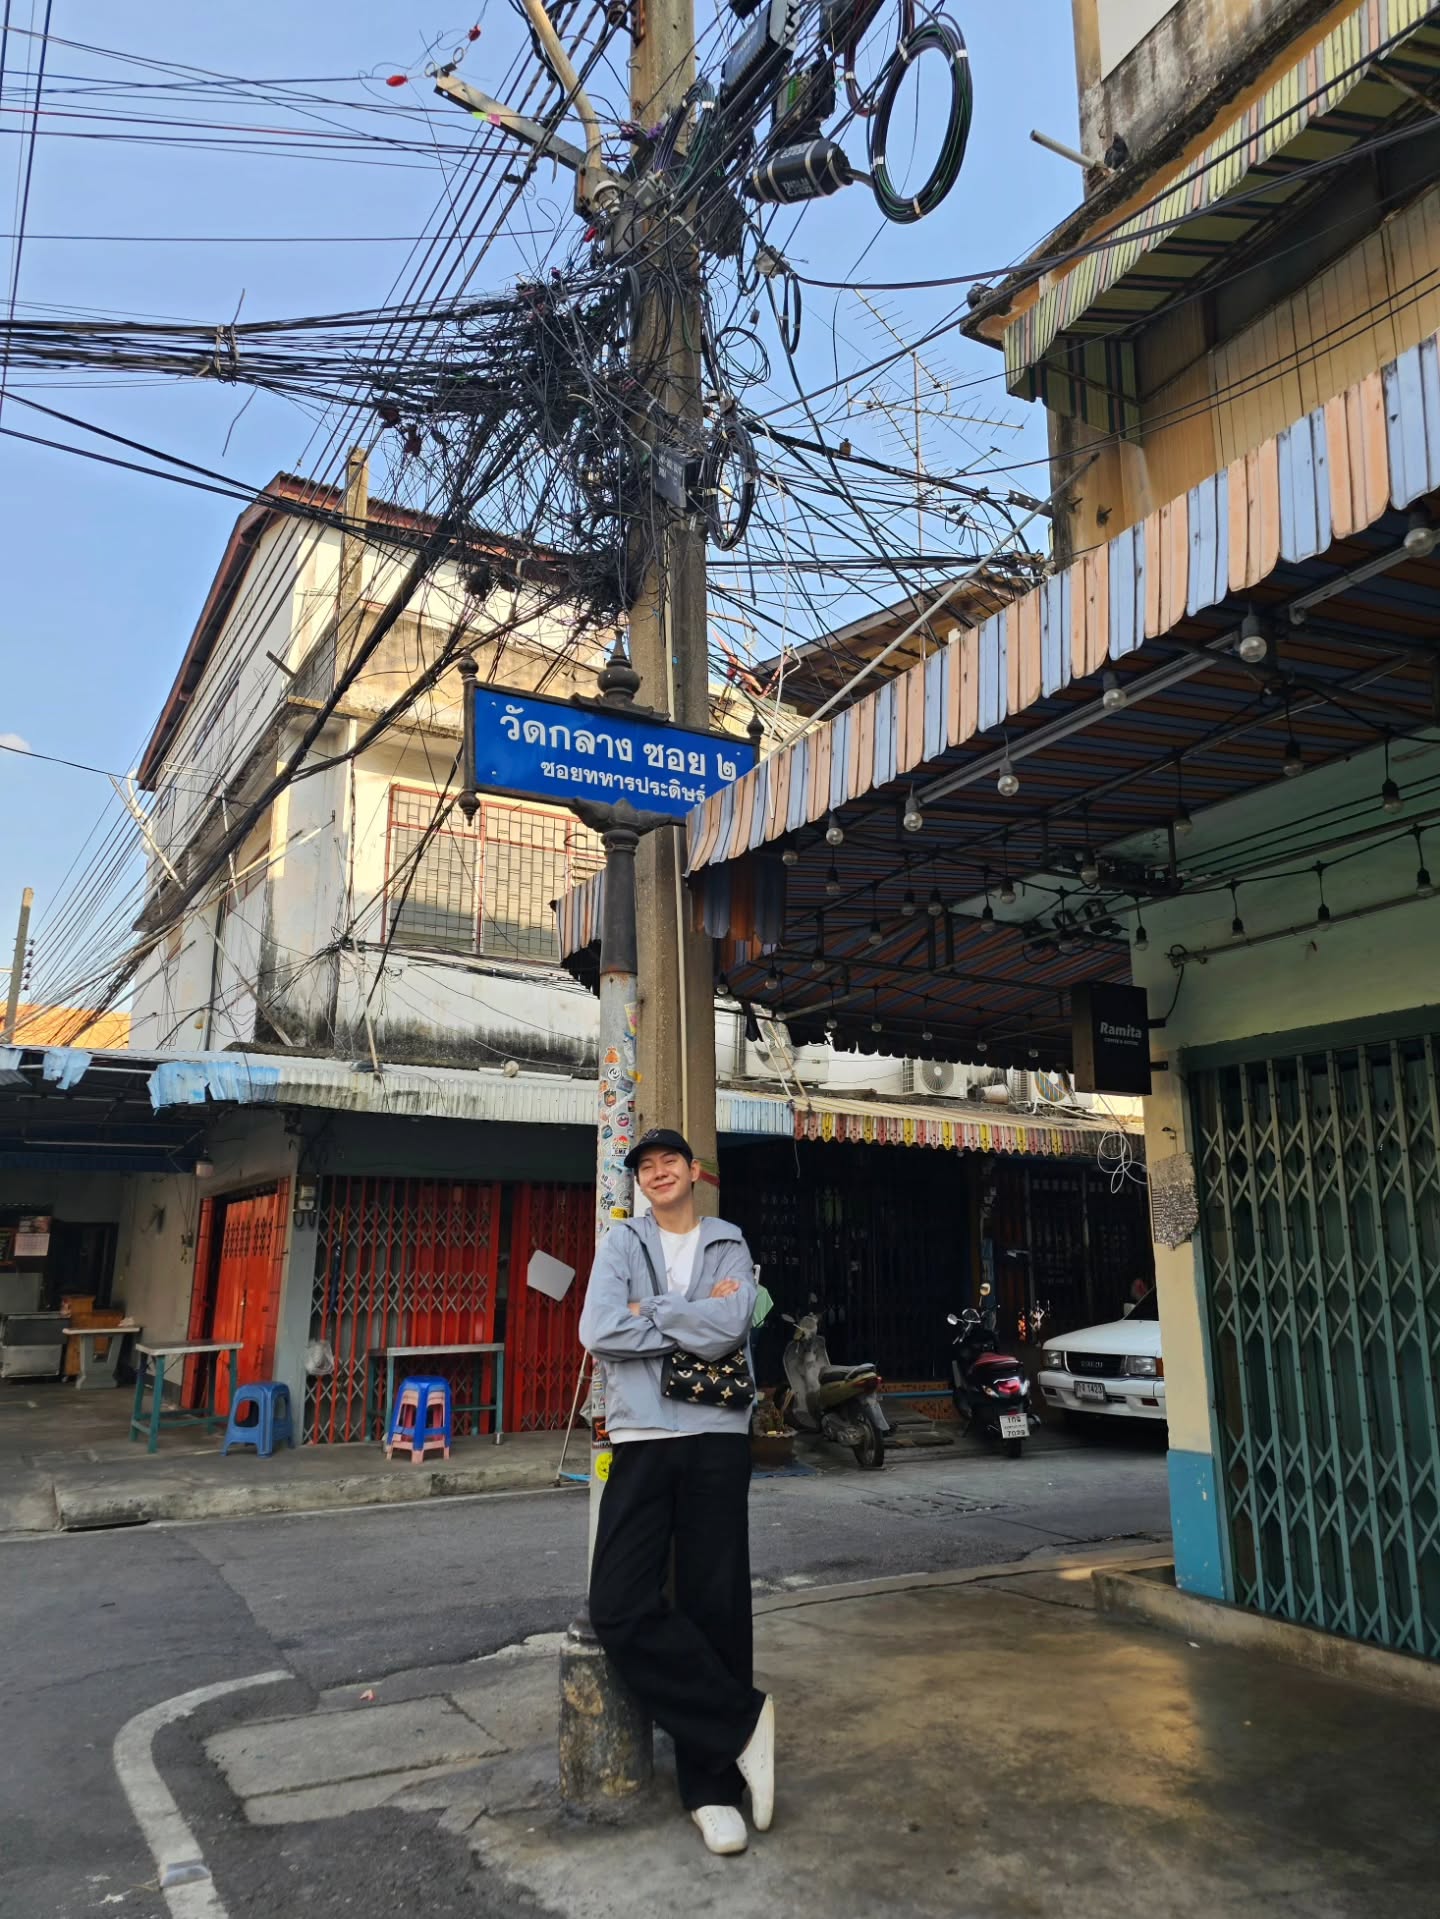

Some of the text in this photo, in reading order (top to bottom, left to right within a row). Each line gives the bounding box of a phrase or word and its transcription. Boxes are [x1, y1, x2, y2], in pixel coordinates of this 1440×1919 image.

[499, 704, 737, 782] วัดกลาง ซอย ๒
[1100, 1021, 1142, 1039] Ramita
